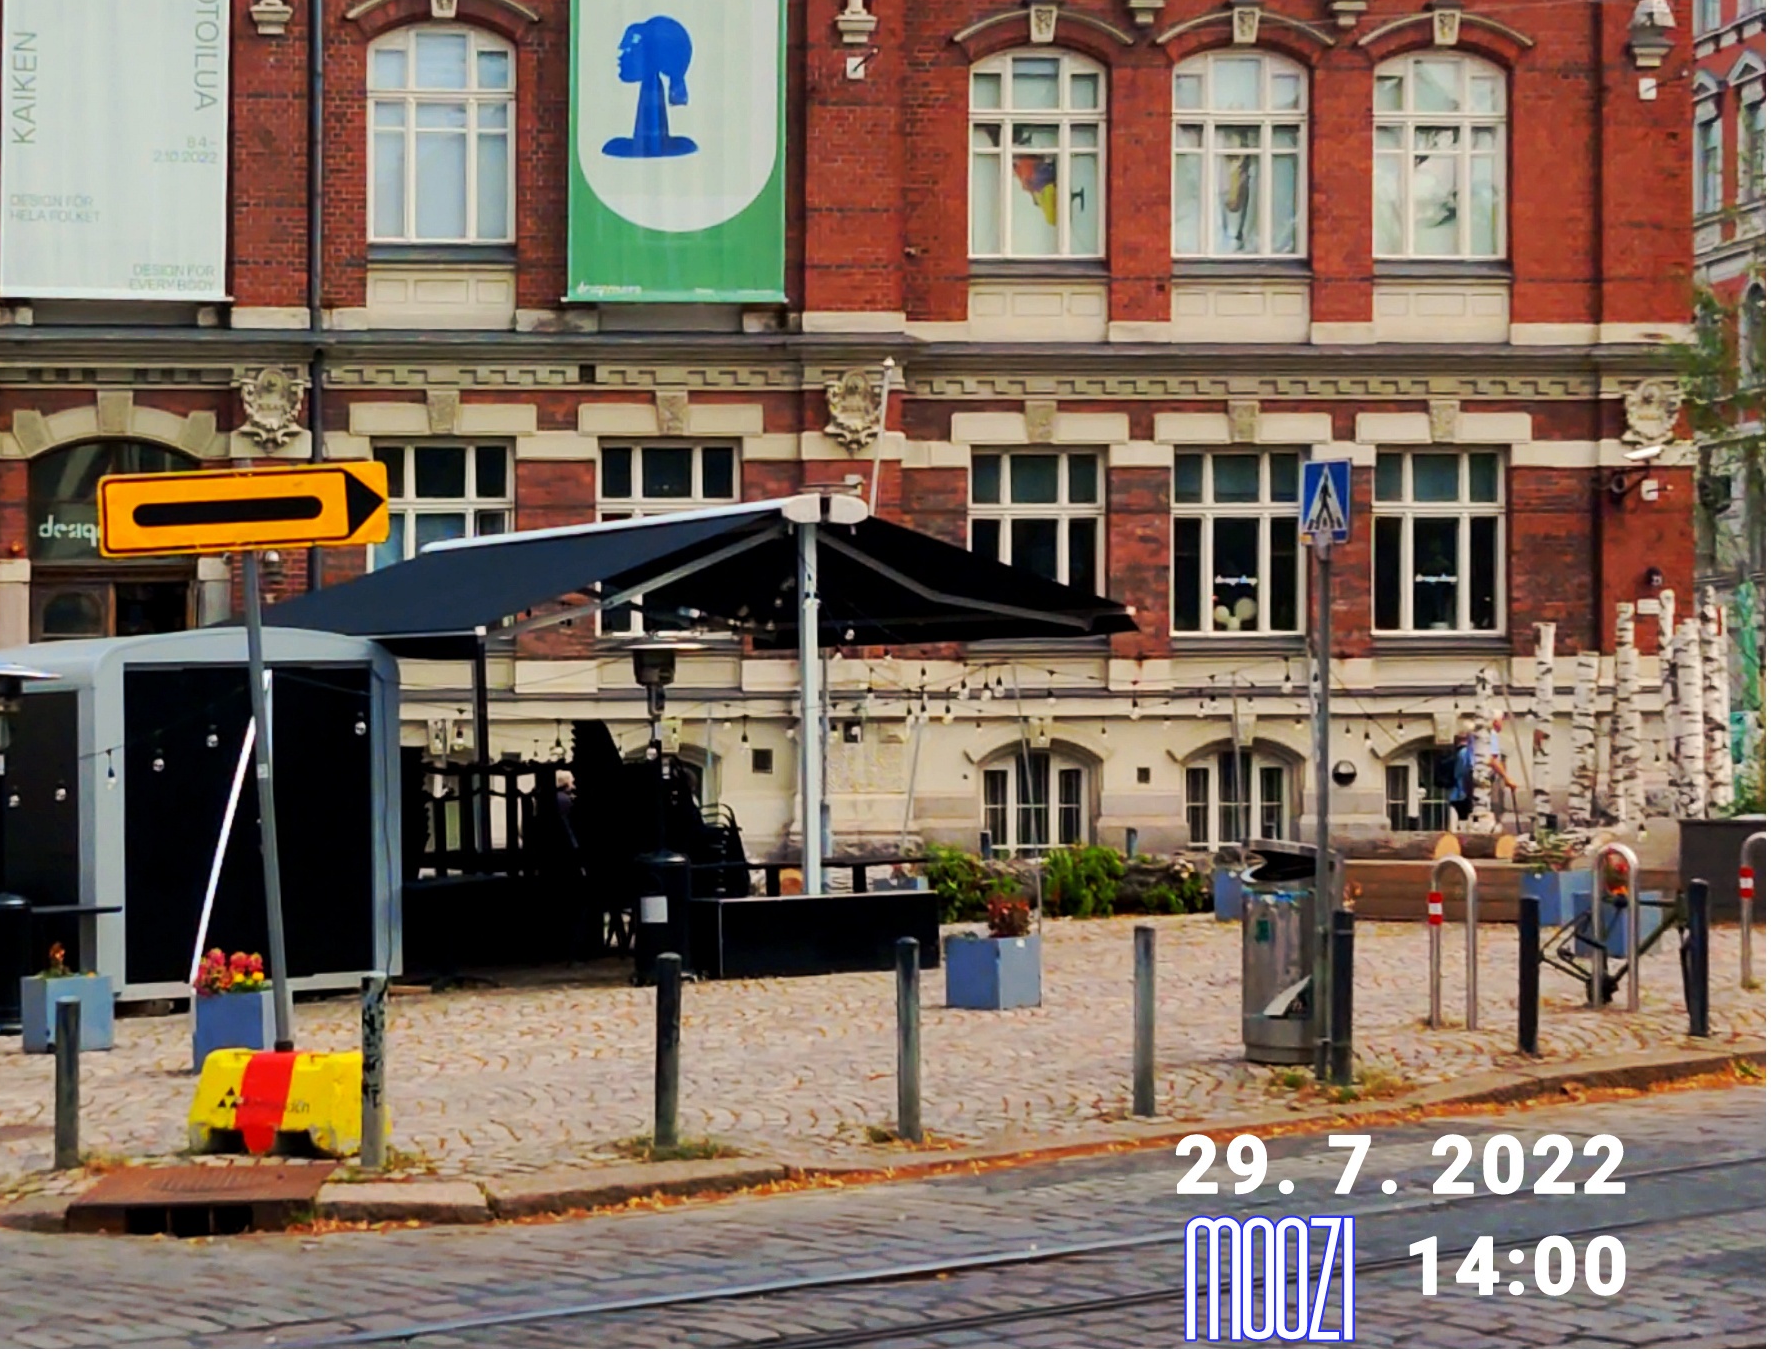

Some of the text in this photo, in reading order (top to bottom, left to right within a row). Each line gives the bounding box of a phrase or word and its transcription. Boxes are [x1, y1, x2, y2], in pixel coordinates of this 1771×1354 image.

[12, 32, 37, 144] KAIKEN
[10, 193, 62, 207] DESIGN
[10, 209, 46, 222] HELA
[132, 263, 215, 277] DESIGN FOR
